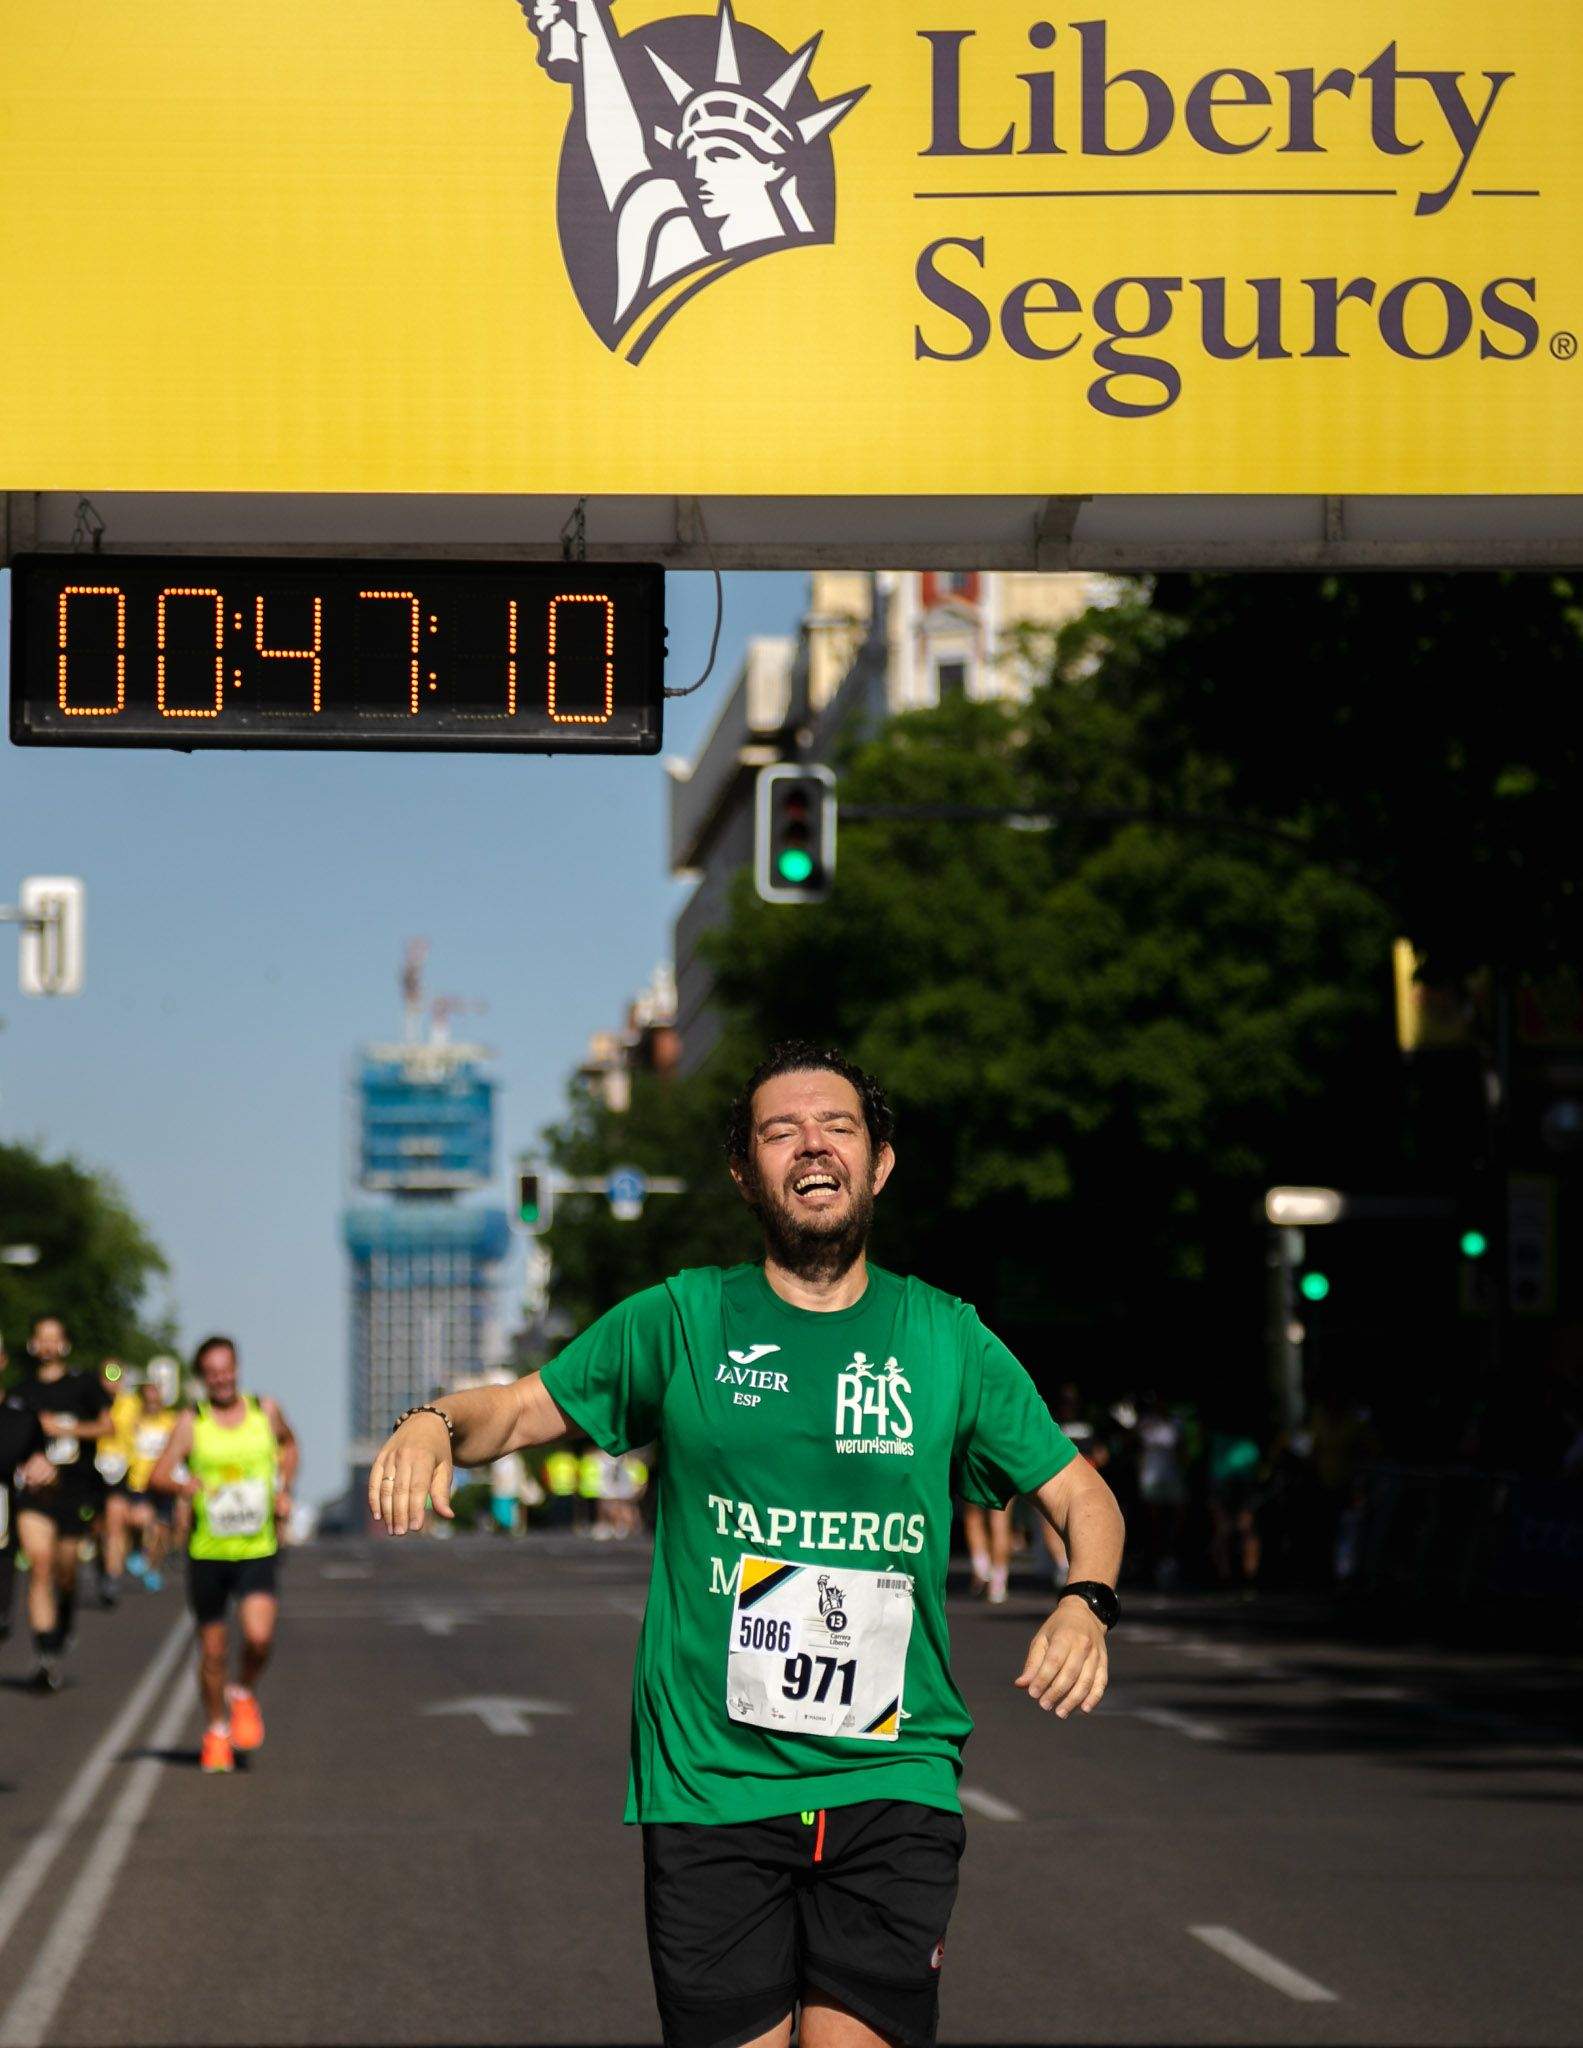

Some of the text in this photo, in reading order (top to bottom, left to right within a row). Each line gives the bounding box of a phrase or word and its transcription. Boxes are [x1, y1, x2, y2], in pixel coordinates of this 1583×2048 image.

[916, 20, 1515, 217] Liberty
[915, 236, 1540, 419] Seguros
[58, 586, 614, 723] 00:47:10
[714, 1363, 790, 1393] JAVIER
[733, 1392, 761, 1407] ESP
[835, 1373, 913, 1438] R4S
[835, 1436, 915, 1456] werun4smiles
[708, 1494, 925, 1554] TAPIEROS
[739, 1616, 792, 1653] 5086
[830, 1614, 844, 1628] 13
[830, 1633, 851, 1641] Carrera
[829, 1639, 850, 1647] Liberty
[781, 1653, 857, 1706] 971
